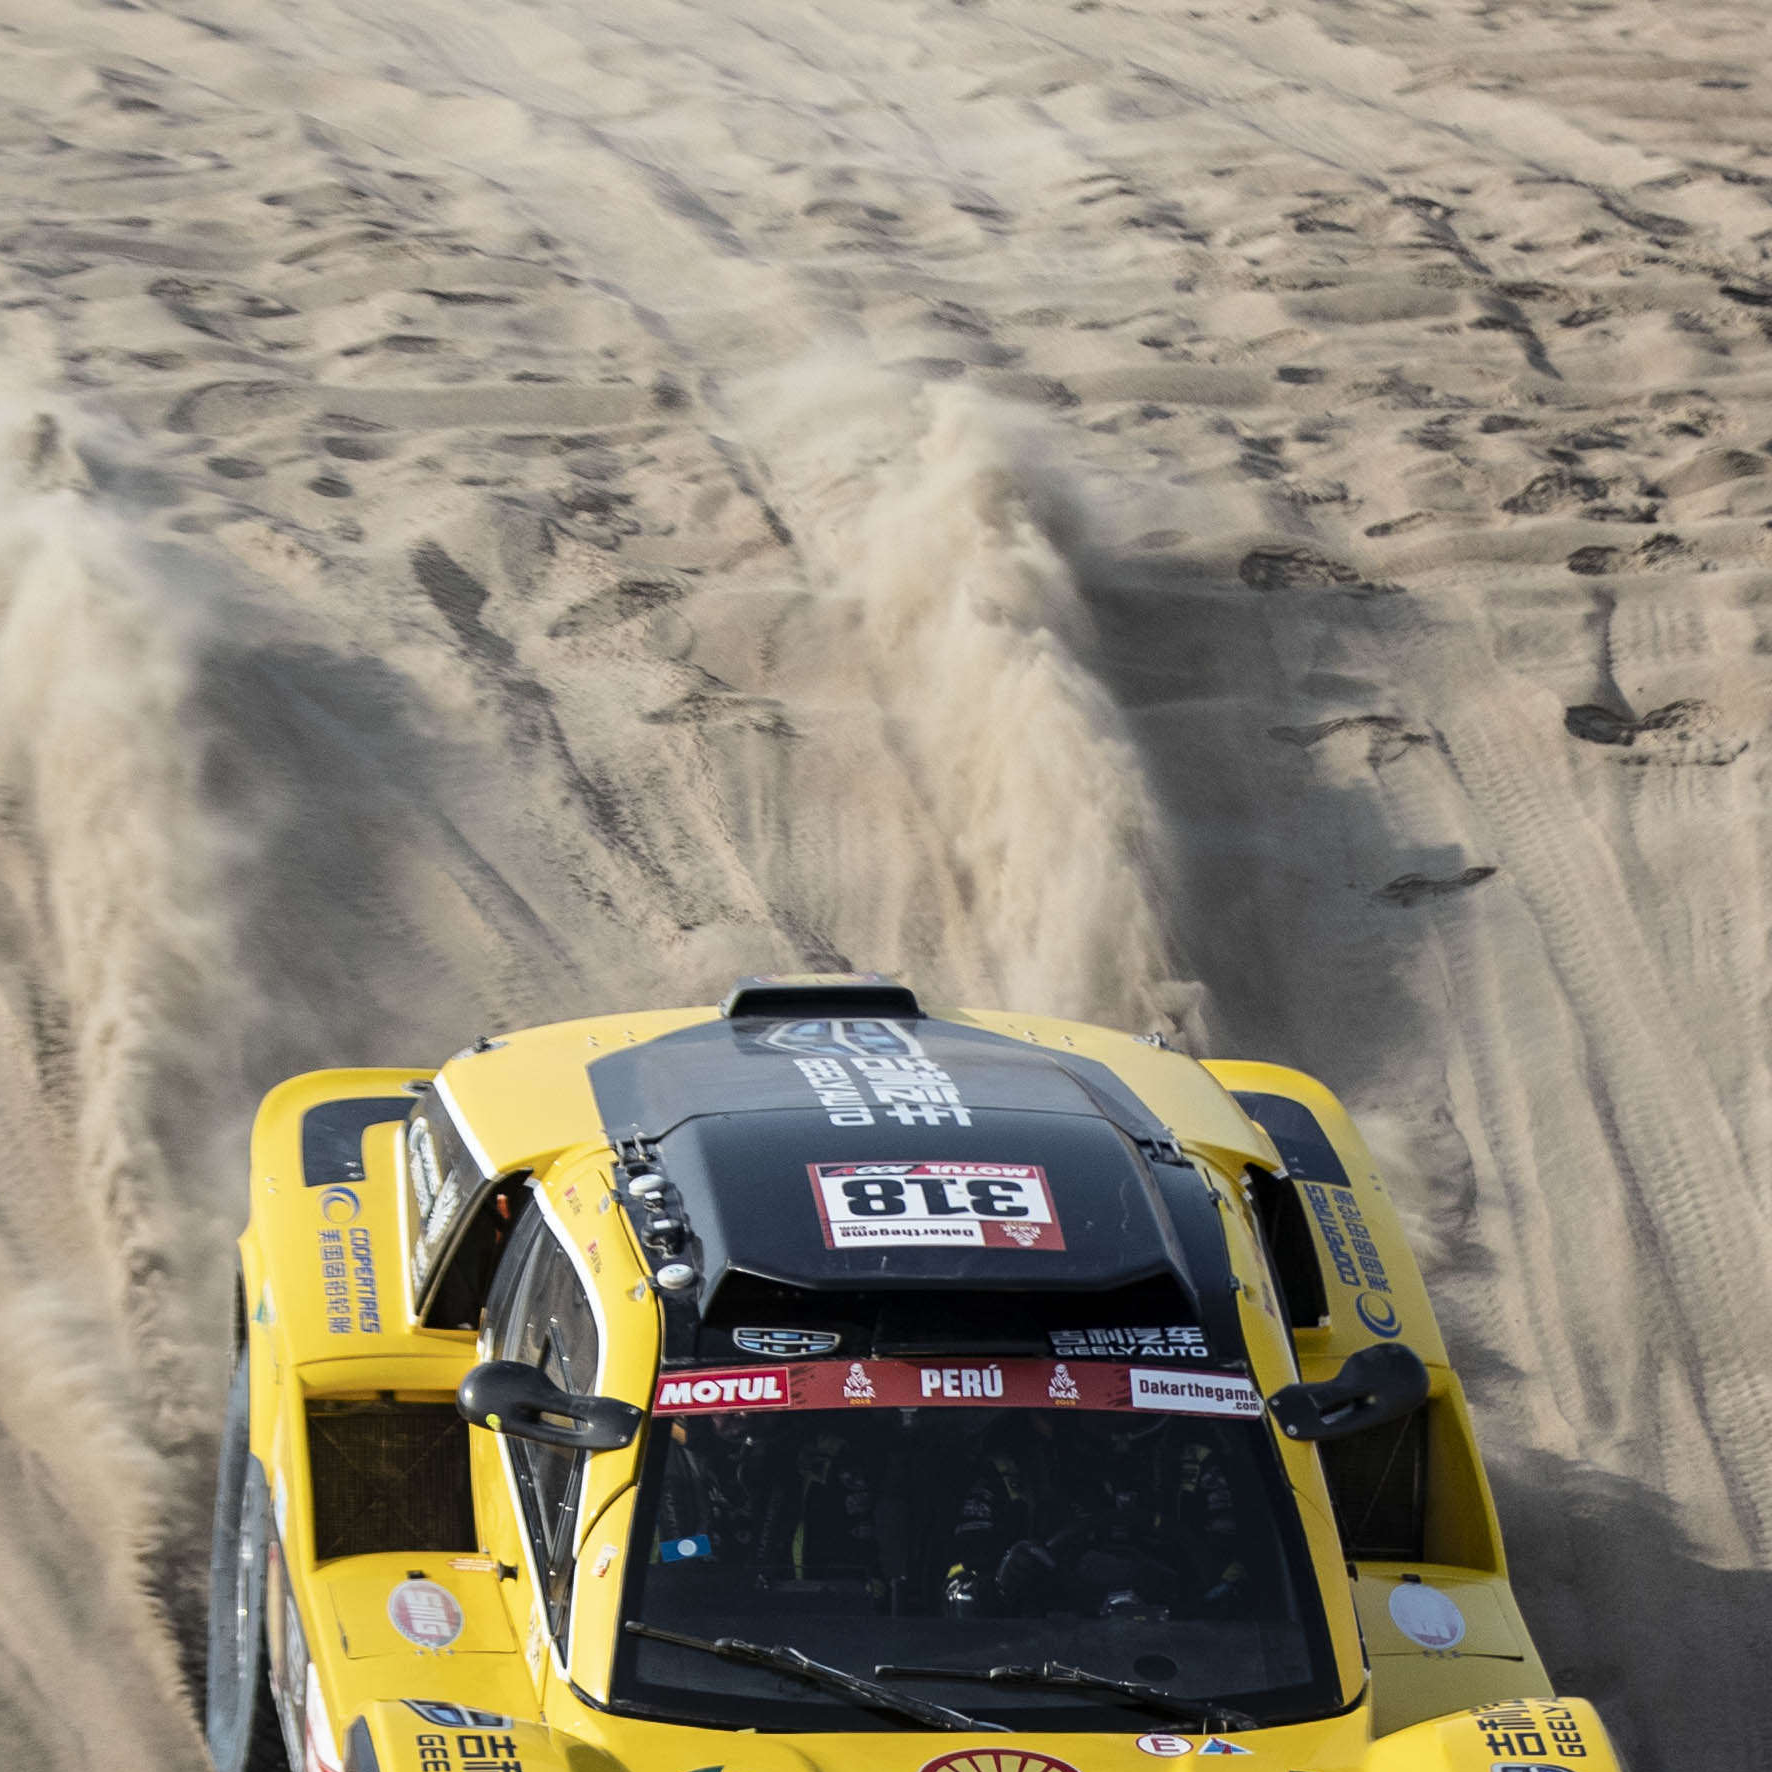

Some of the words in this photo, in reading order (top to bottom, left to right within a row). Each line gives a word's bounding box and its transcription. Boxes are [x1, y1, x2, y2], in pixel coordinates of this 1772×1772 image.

[813, 1089, 875, 1126] AUTO
[925, 1164, 1029, 1177] MOTUL
[841, 1178, 1030, 1217] 318
[1050, 1326, 1205, 1345] 吉利汽车
[1056, 1346, 1138, 1357] GEELY
[1140, 1346, 1209, 1357] AUTO
[658, 1376, 782, 1405] MOTUL
[920, 1364, 1004, 1398] PERÚ
[1152, 1737, 1180, 1753] E
